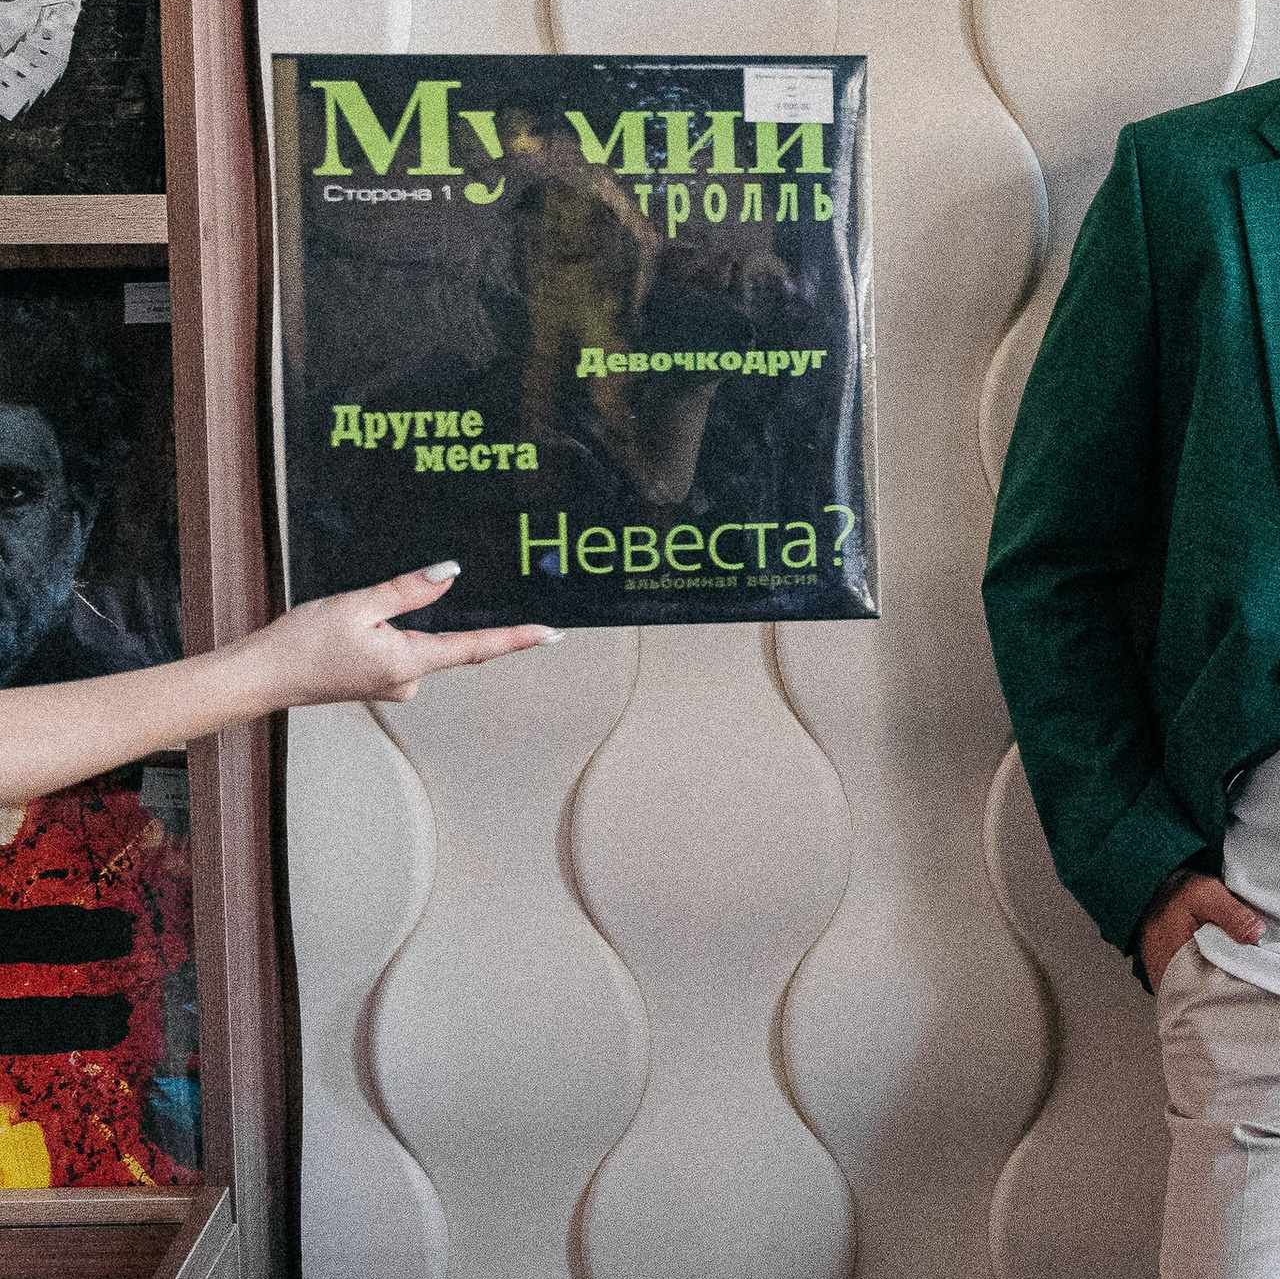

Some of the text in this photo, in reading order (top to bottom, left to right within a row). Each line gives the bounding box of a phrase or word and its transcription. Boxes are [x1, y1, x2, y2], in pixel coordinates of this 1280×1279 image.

[323, 184, 452, 204] Сторона 1
[576, 346, 828, 378] Девочкодруг
[330, 404, 484, 449] Другие
[413, 440, 539, 473] места
[519, 504, 857, 576] Невеста?
[746, 573, 818, 590] версия
